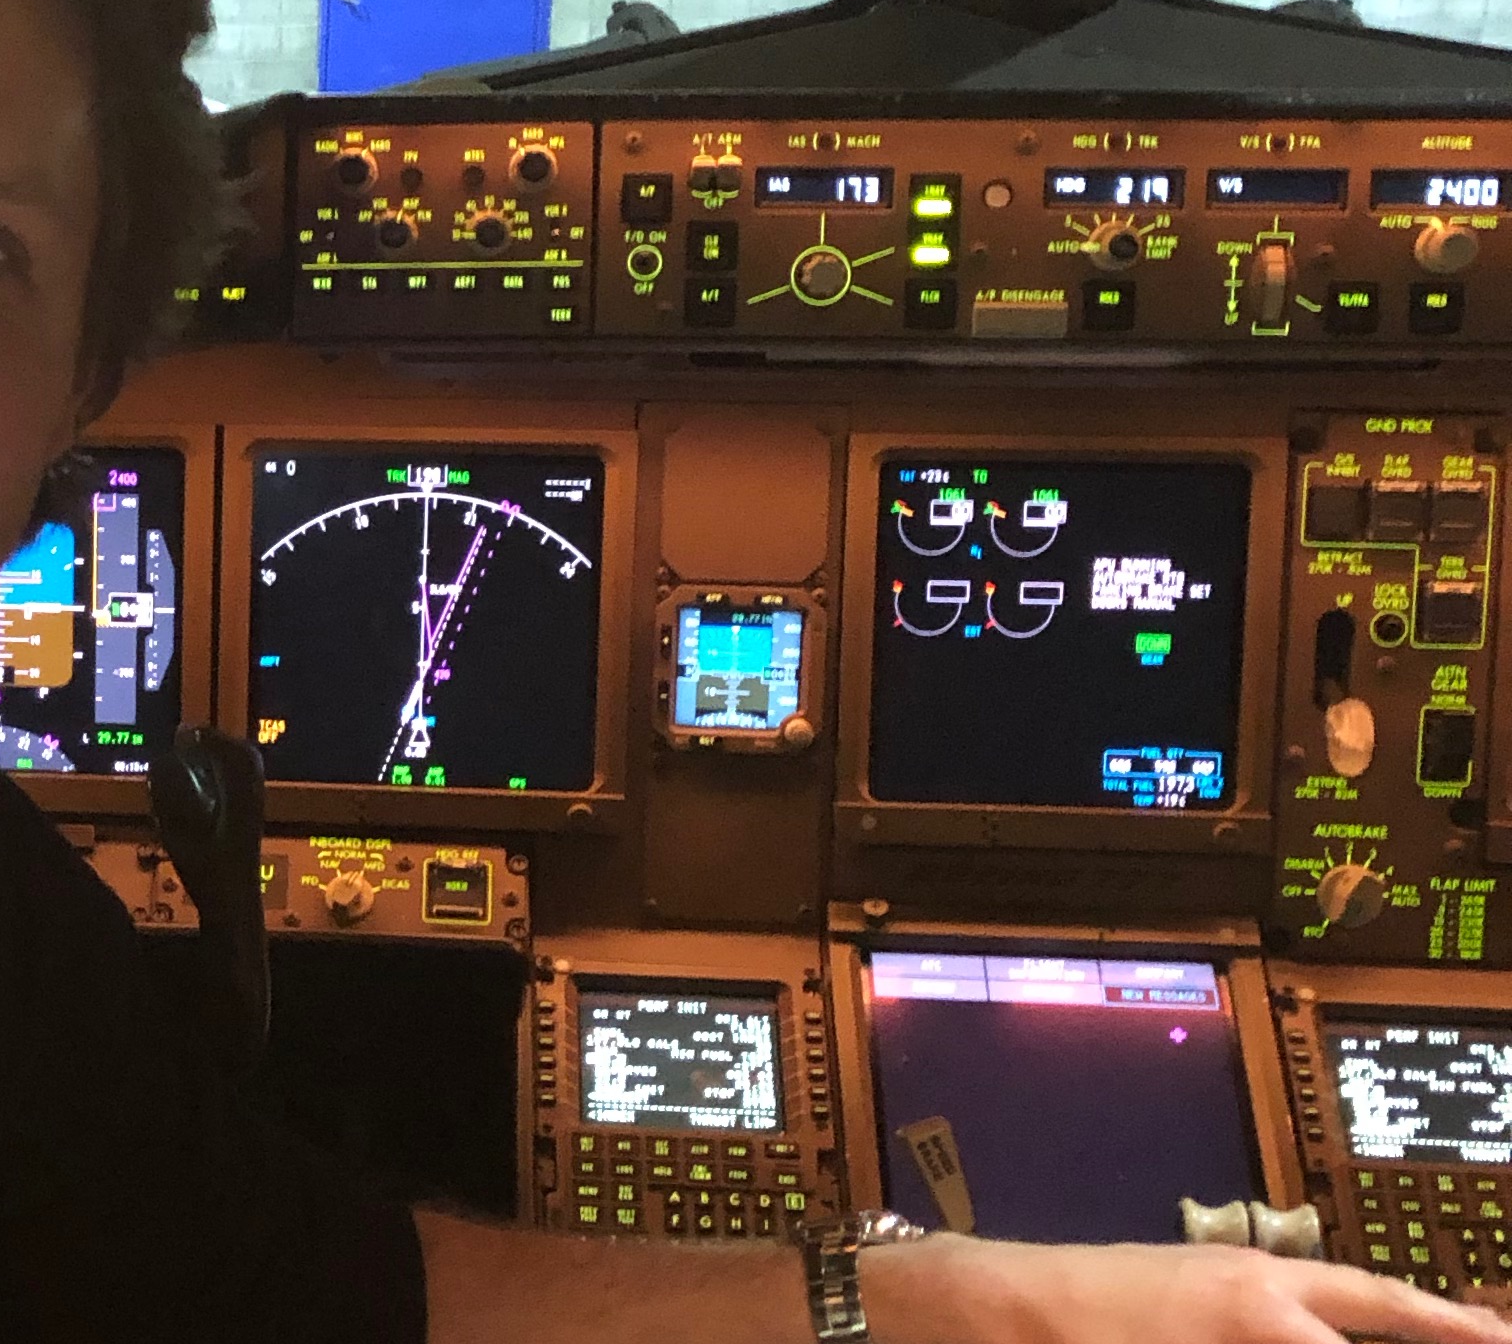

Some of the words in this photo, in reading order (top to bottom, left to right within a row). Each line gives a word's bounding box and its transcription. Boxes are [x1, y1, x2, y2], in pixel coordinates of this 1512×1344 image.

[789, 136, 807, 147] IAS
[847, 136, 881, 148] MACH
[1073, 136, 1097, 149] HDG
[1139, 136, 1159, 149] TRK
[1300, 136, 1321, 149] FPA
[1422, 136, 1473, 151] ALTITUDE
[769, 178, 790, 192] IAS
[837, 177, 879, 202] 173
[1056, 178, 1085, 194] HDG
[1116, 178, 1169, 205] 219
[1219, 178, 1242, 194] V/S
[1427, 178, 1499, 206] 2400
[1380, 215, 1411, 228] AUTO
[1048, 240, 1079, 253] AUTO
[1217, 242, 1253, 255] DOWN
[635, 283, 654, 295] OFF
[1001, 289, 1065, 303] DISENGAGE
[1366, 418, 1396, 432] GND
[110, 471, 138, 485] 2400
[387, 469, 406, 483] TRK
[449, 471, 470, 484] MAG
[900, 470, 916, 482] TAT
[973, 469, 989, 484] TO
[1190, 584, 1212, 598] SET
[1375, 583, 1407, 596] LOCK
[1337, 593, 1353, 607] UP
[1373, 596, 1408, 610] OVRD
[964, 625, 982, 637] EGT
[1431, 678, 1467, 691] GEAR
[259, 719, 285, 733] TCAS
[98, 733, 129, 745] 29.77
[258, 732, 279, 744] OFF
[1103, 779, 1129, 791] TOTAL
[1133, 780, 1155, 791] FUEL
[1424, 788, 1462, 798] DOWN
[1314, 824, 1388, 840] AUTOBRAKE
[310, 837, 361, 849] INBOARD
[334, 850, 366, 860] NORM
[320, 860, 340, 870] NAV
[364, 861, 385, 872] MFD
[301, 876, 318, 885] PFD
[382, 879, 410, 890] EICAS
[1430, 876, 1460, 890] FLAP
[1464, 878, 1496, 892] LIMIT
[1121, 990, 1145, 1001] NEW
[1150, 991, 1205, 1003] MESSAGES
[638, 1000, 668, 1012] PERF
[677, 1001, 707, 1014] INIT
[1387, 1030, 1418, 1042] PERF
[1428, 1032, 1459, 1044] INIT
[702, 1050, 733, 1061] FUEL
[669, 1191, 680, 1202] A
[701, 1192, 709, 1204] B
[730, 1193, 740, 1205] C
[760, 1195, 770, 1206] D
[672, 1216, 680, 1226] F
[700, 1216, 712, 1228] G
[732, 1218, 741, 1229] H
[764, 1220, 768, 1229] I
